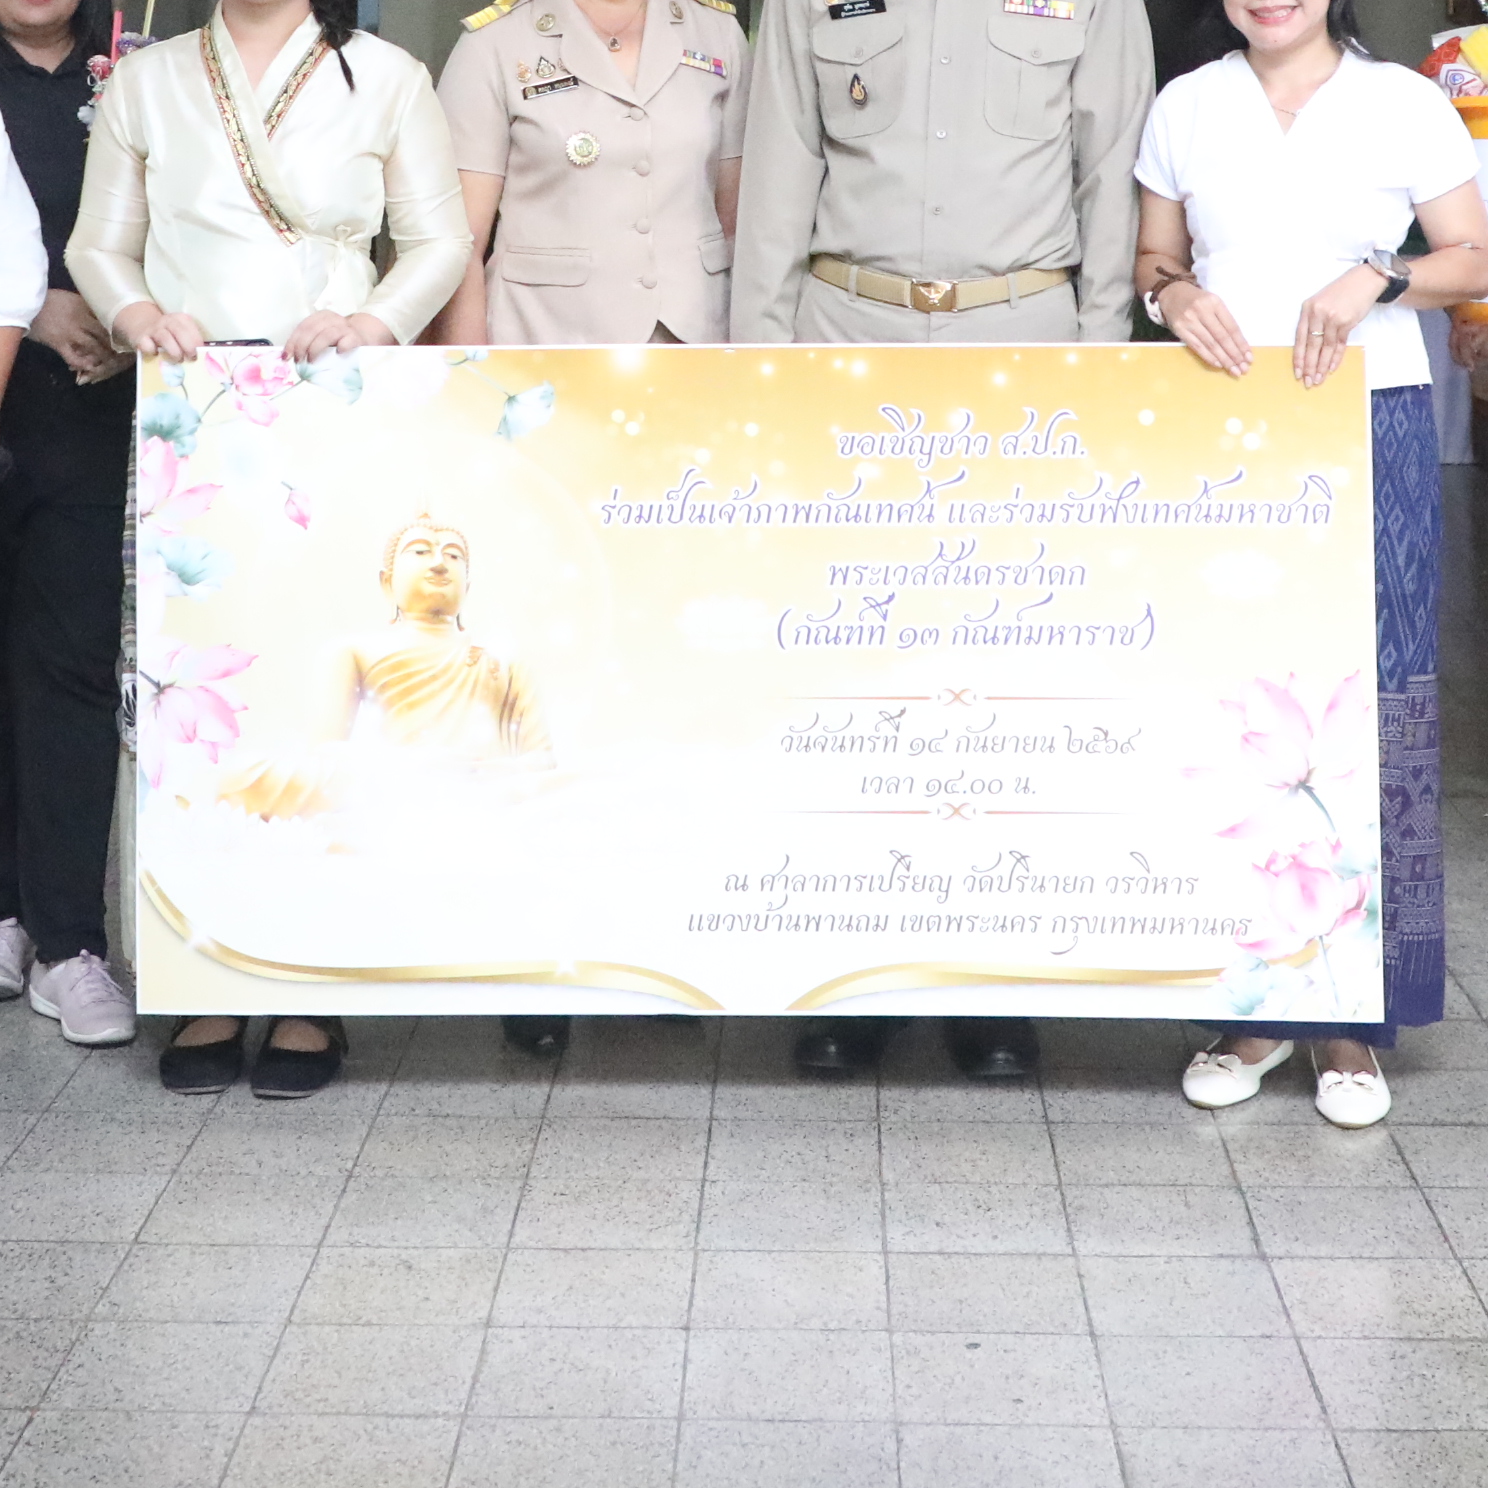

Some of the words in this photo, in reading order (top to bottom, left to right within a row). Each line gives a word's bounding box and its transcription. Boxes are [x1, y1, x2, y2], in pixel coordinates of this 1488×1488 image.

[838, 406, 990, 469] ขอเชิญชาว
[1001, 408, 1087, 456] ส.ป.ก.
[829, 538, 1086, 586] พระเวสสันดรชาดก
[952, 592, 1155, 651] กัณฑ์มหาราช)
[908, 728, 948, 756] ๑๔
[955, 712, 1055, 754] กันยายน
[1063, 725, 1142, 755] ๒๕๖๙
[860, 775, 915, 795] เวลา
[1014, 776, 1037, 795] น.
[724, 874, 749, 892] ณ
[760, 849, 952, 904] ศาลาการเปรียญ
[963, 850, 1095, 894] วัดปรินายก
[1105, 851, 1200, 896] วรวิหาร
[688, 893, 889, 933] แขวงบ้านพานถม
[900, 913, 1043, 934] เขตพระนคร
[1049, 914, 1253, 955] กรุงเทพมหานคร
